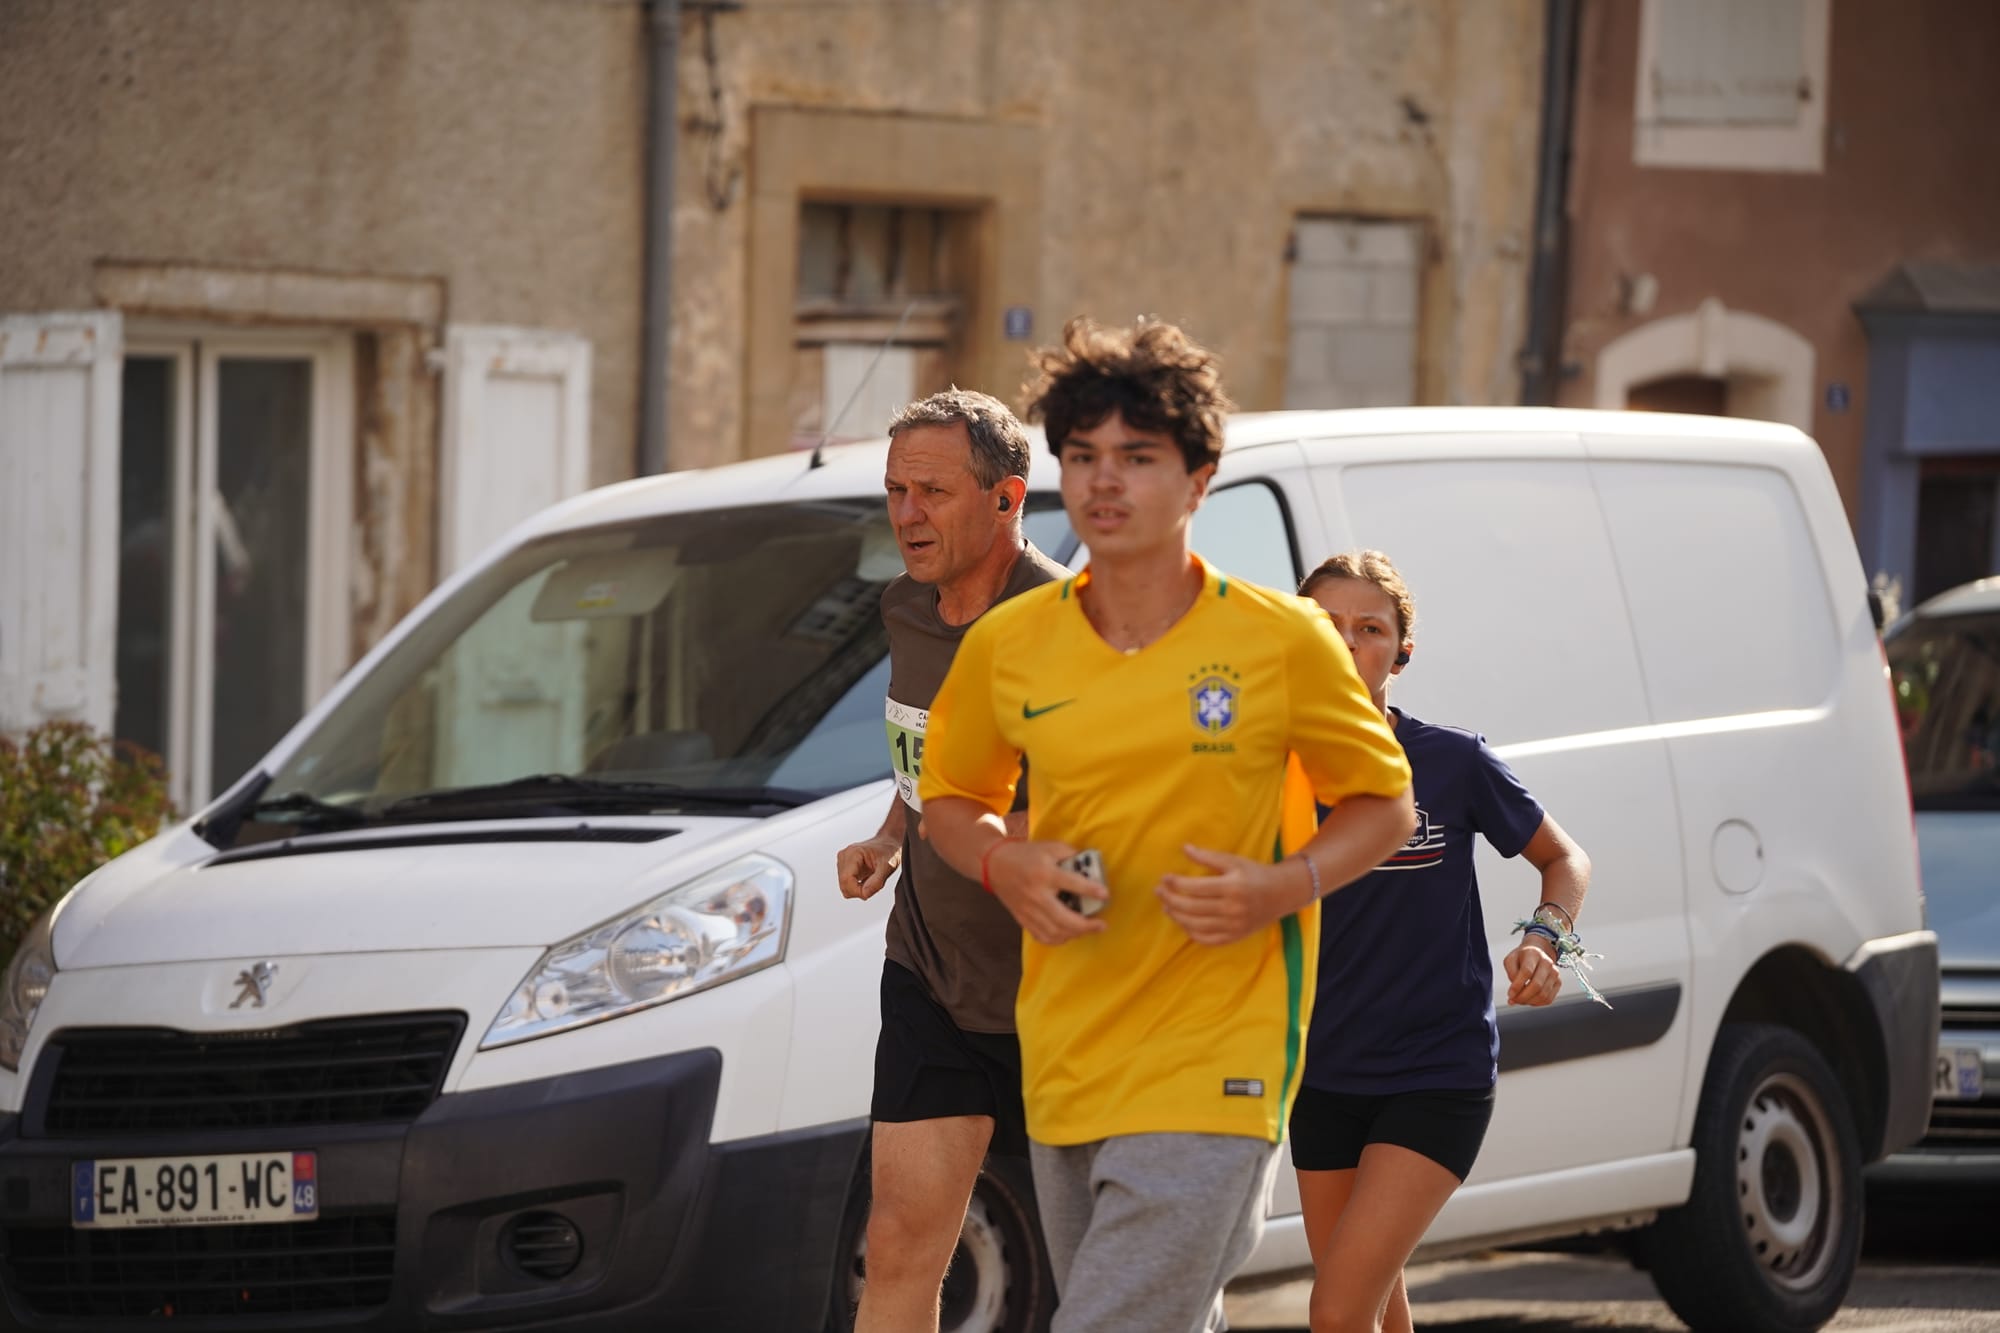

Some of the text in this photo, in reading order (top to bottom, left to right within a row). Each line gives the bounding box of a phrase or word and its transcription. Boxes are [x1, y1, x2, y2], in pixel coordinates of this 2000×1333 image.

[1192, 743, 1234, 752] BRASIL
[99, 1160, 286, 1214] EA-891-WC
[294, 1185, 314, 1207] 48
